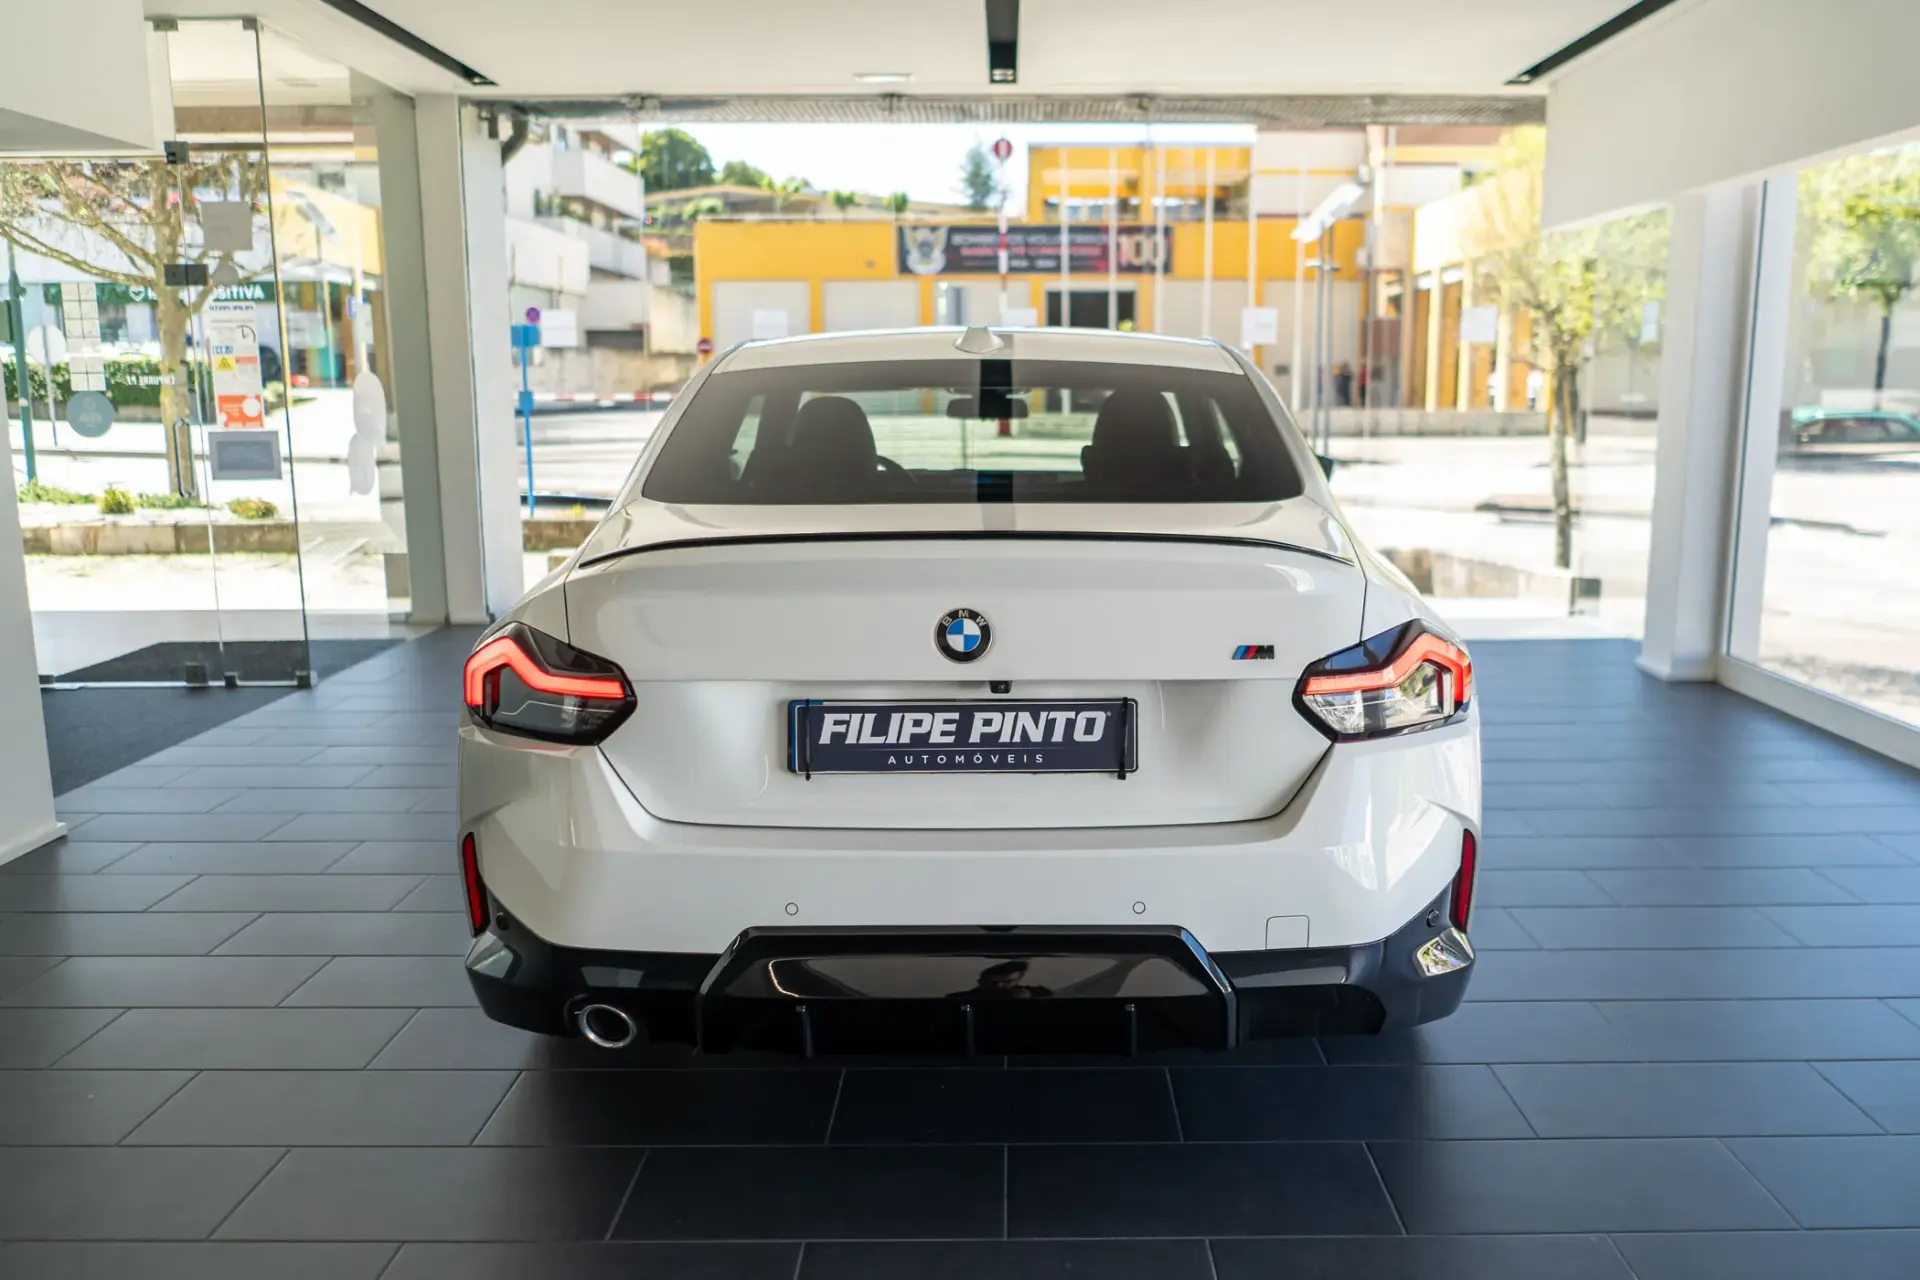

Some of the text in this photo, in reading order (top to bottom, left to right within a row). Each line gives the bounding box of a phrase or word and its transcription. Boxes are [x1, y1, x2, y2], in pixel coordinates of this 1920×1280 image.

[941, 609, 988, 627] BMW
[818, 712, 960, 744] FILIPE
[887, 752, 1044, 765] AUTOMÓVEIS
